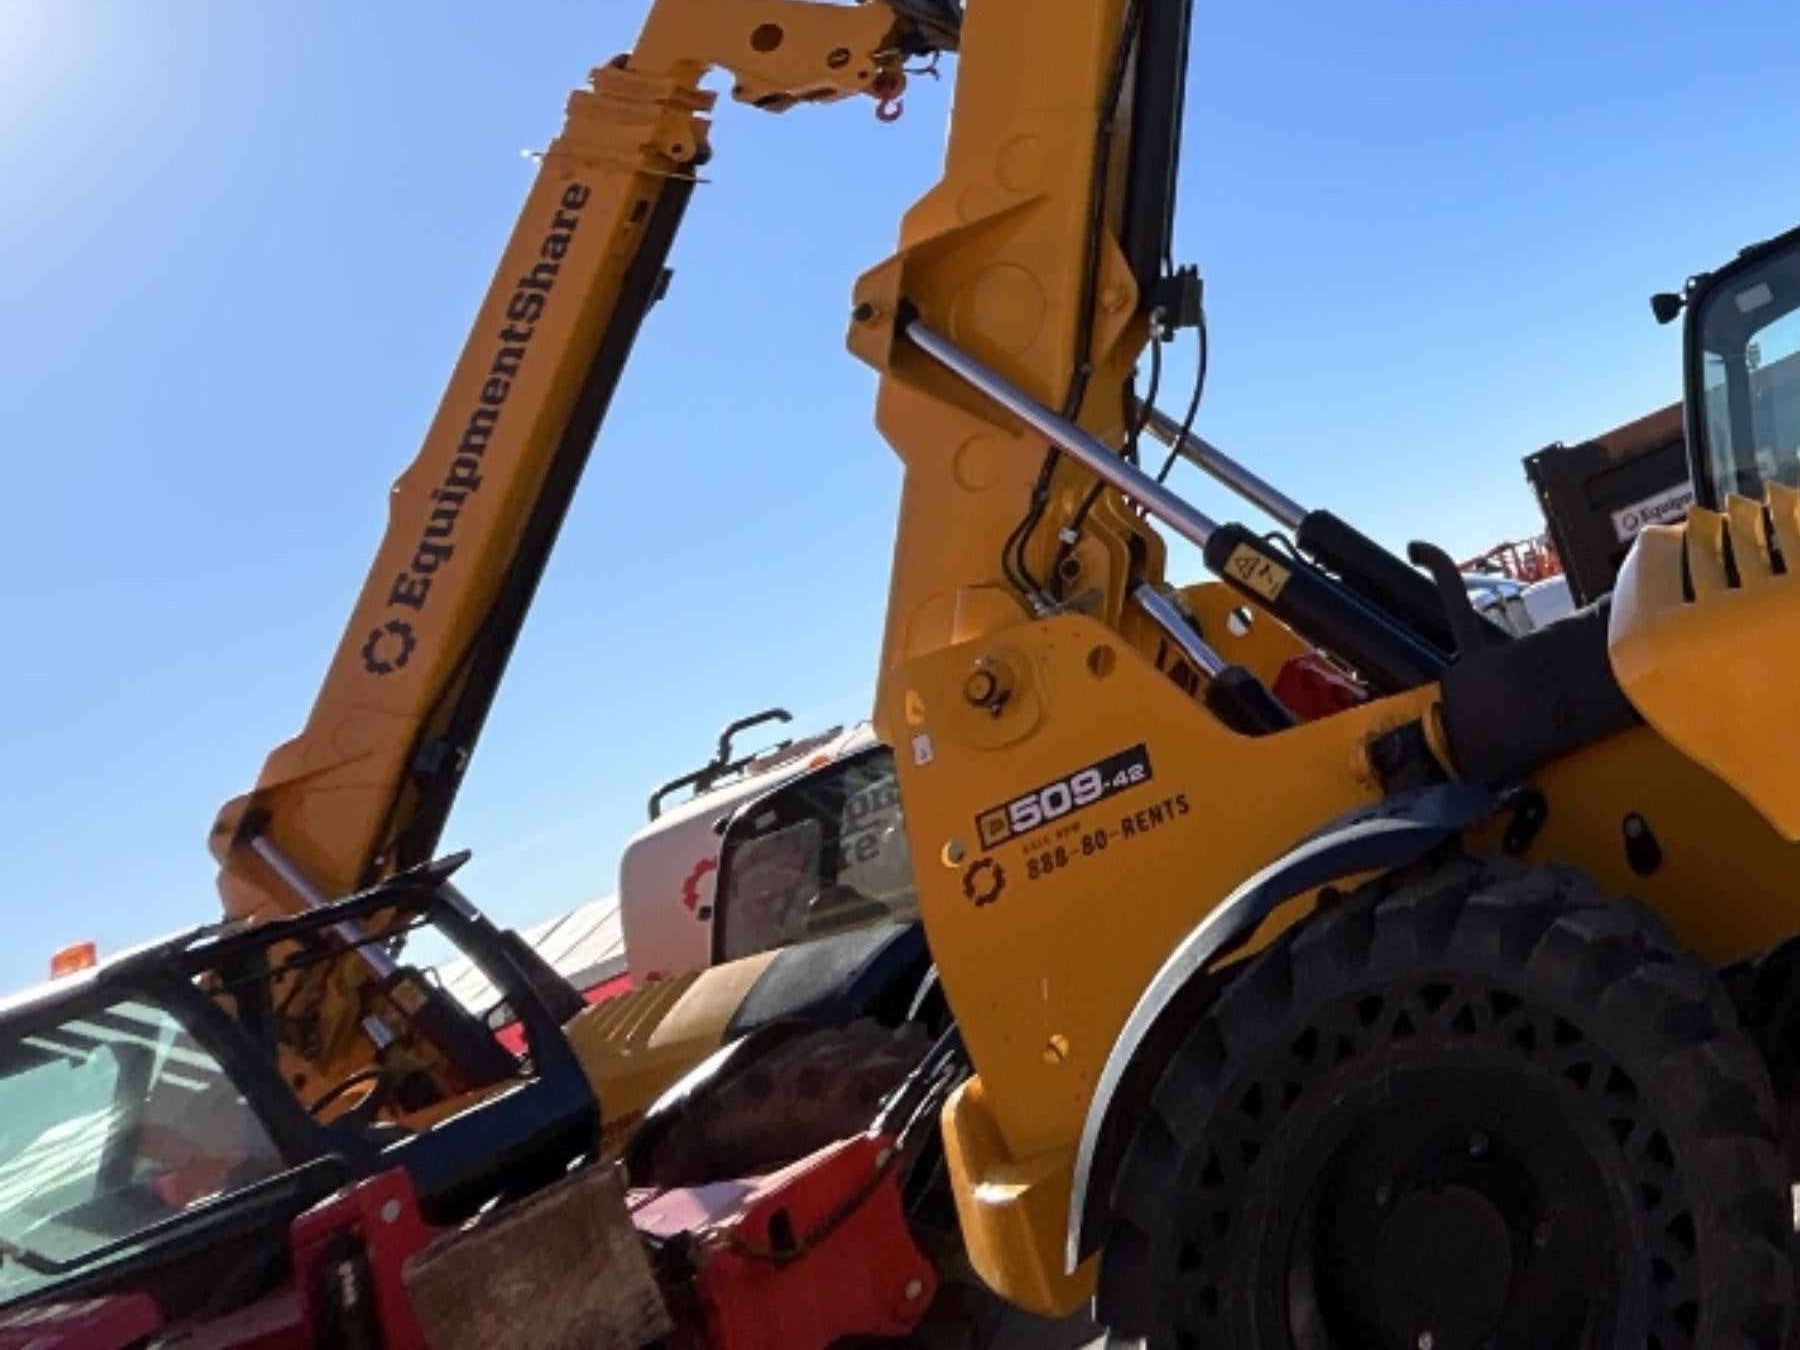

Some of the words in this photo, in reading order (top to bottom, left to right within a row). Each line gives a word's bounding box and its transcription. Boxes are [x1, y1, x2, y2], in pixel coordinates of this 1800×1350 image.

[387, 182, 591, 612] EquipmentShare
[1009, 764, 1146, 833] 509-42
[1027, 795, 1189, 880] 888-80-RENTS
